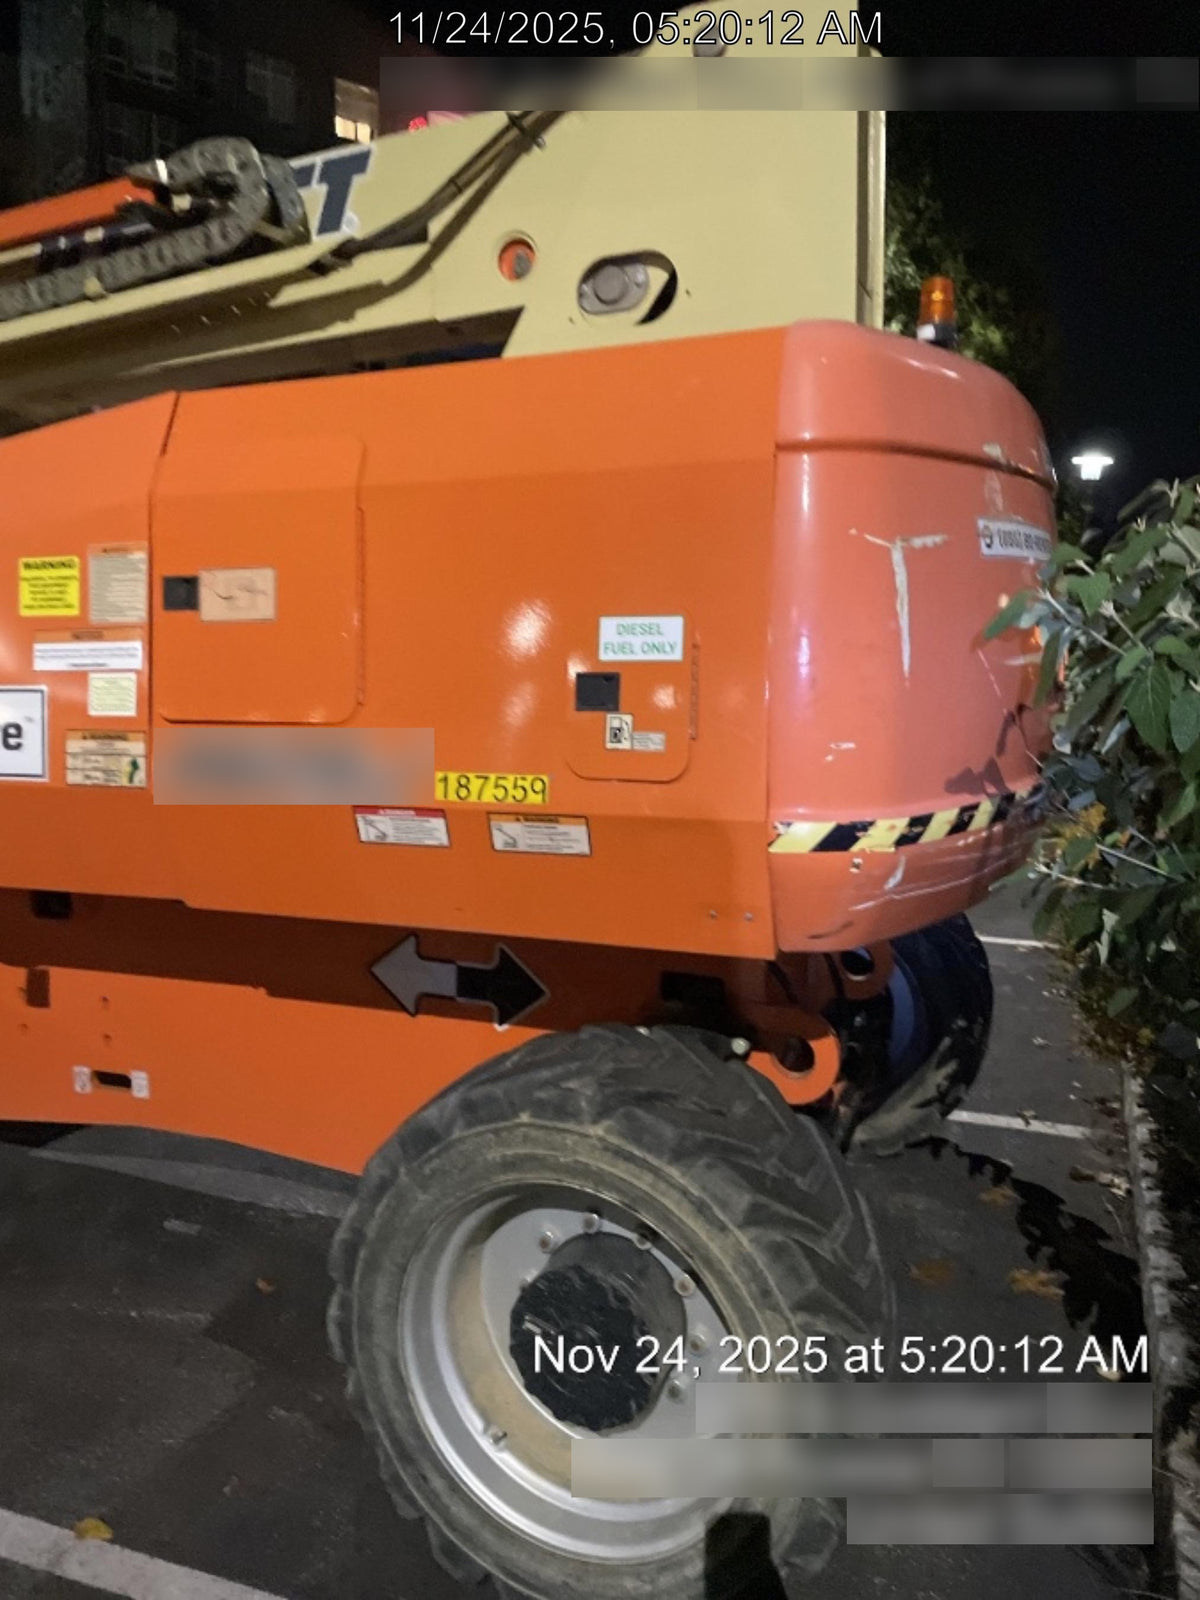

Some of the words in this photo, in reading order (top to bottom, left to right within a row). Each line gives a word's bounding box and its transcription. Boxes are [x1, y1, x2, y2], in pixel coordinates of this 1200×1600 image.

[615, 622, 665, 636] DIESEL
[603, 641, 638, 656] FUEL
[640, 640, 678, 655] ONLY
[437, 774, 548, 804] 187559
